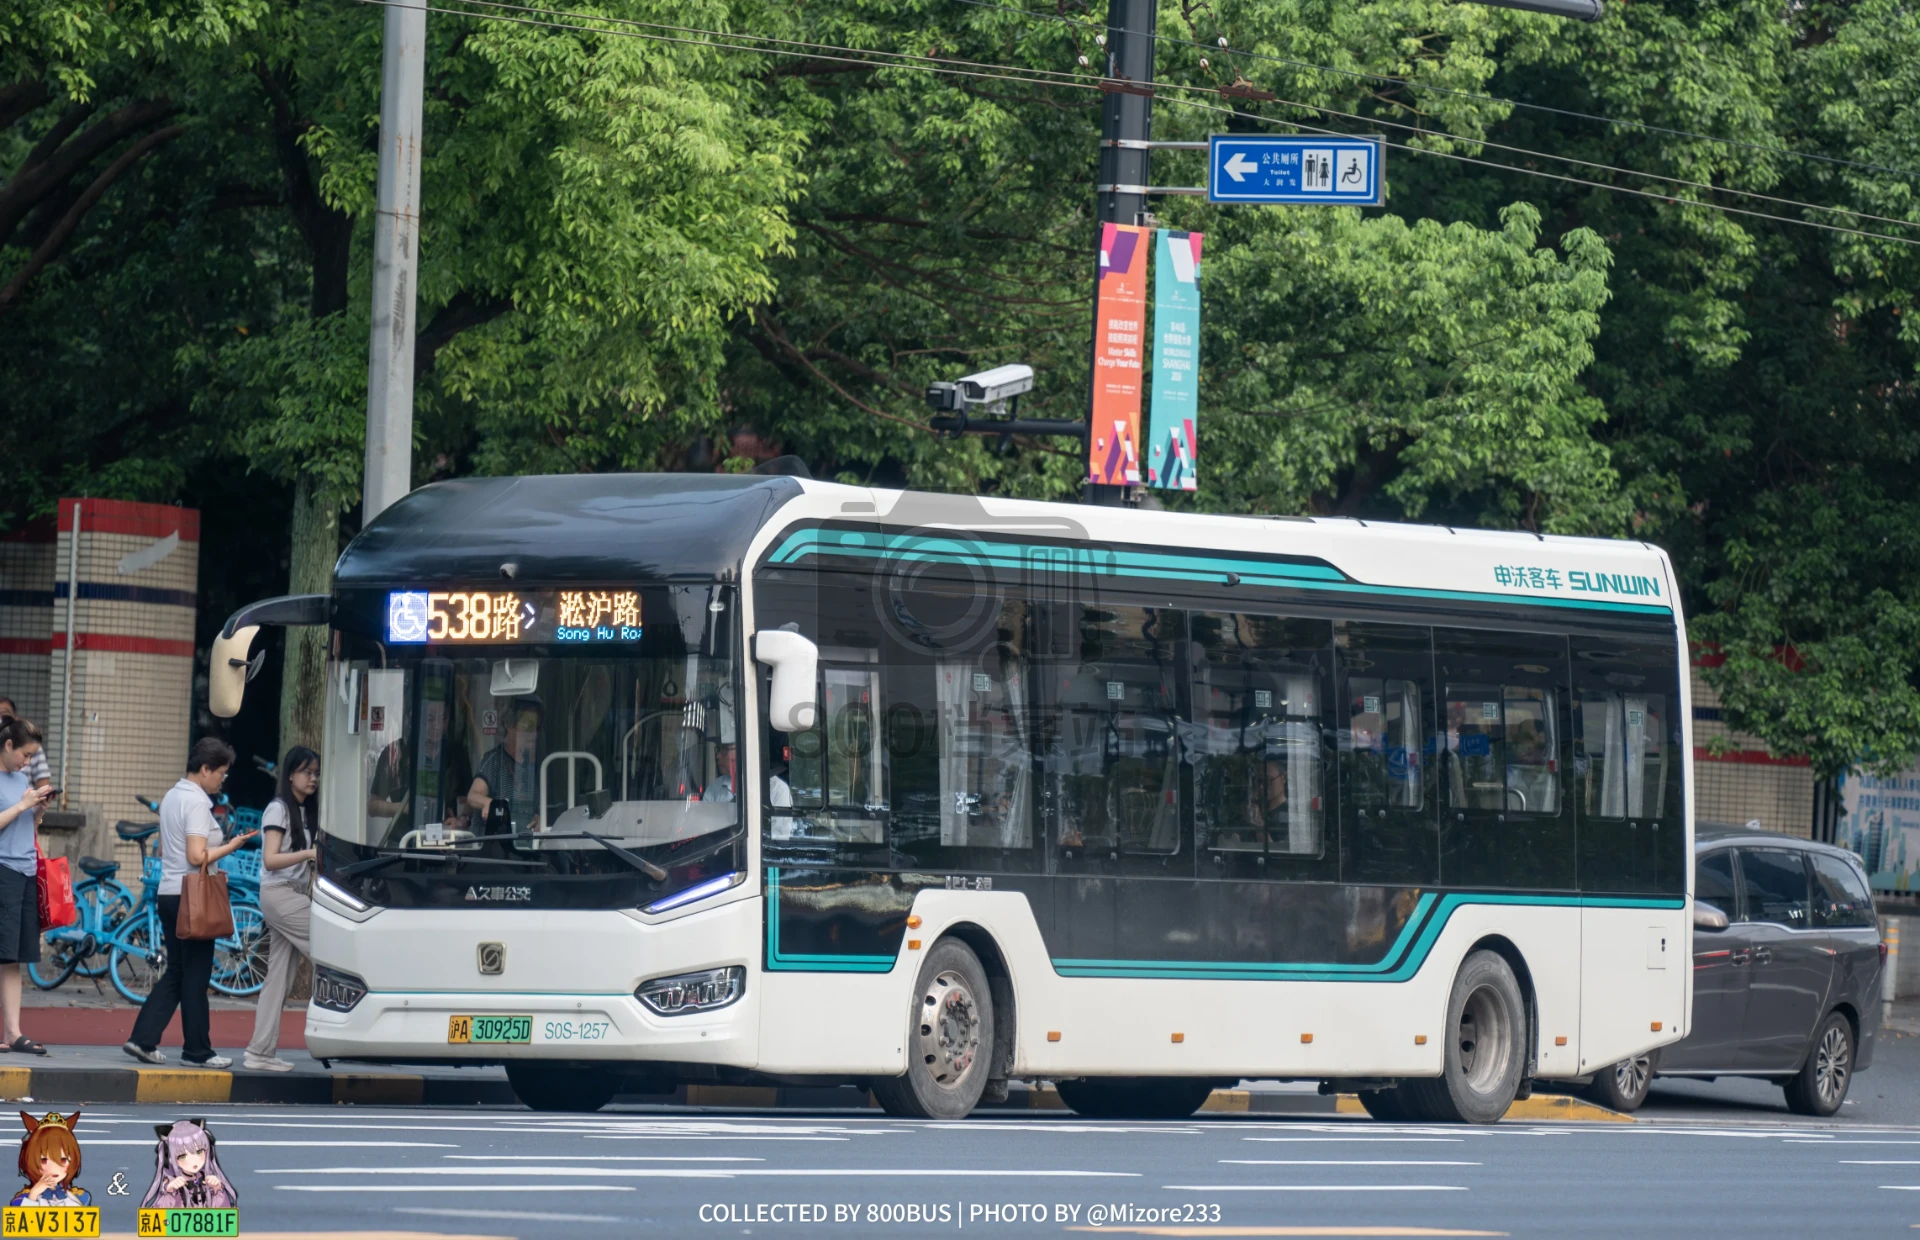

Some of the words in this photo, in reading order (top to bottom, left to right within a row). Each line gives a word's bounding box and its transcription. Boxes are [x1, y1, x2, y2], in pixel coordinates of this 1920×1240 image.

[1262, 152, 1299, 166] 公共厕所
[1493, 564, 1563, 590] 申沃客车
[1568, 570, 1661, 597] SUNWIN
[427, 592, 523, 640] 538路
[559, 591, 639, 628] 淞沪路
[557, 627, 590, 641] Song
[597, 627, 614, 640] Hu
